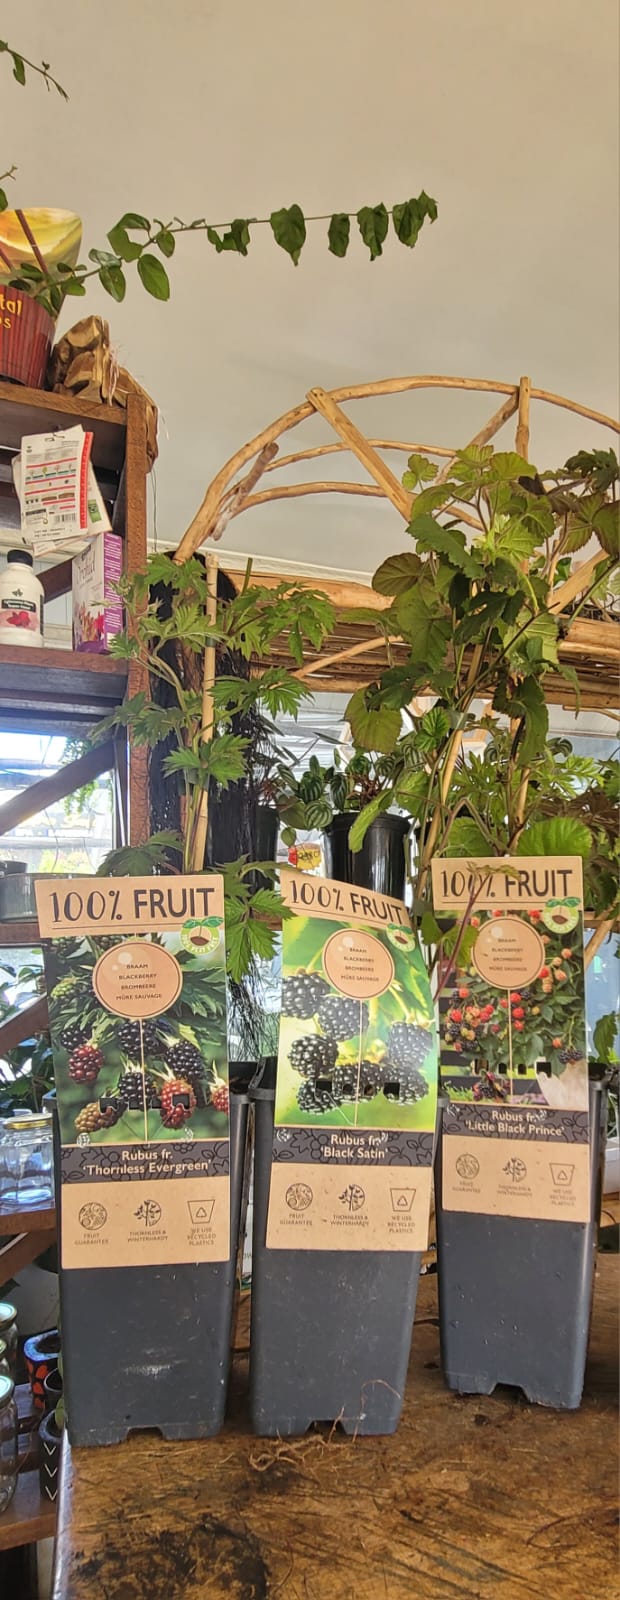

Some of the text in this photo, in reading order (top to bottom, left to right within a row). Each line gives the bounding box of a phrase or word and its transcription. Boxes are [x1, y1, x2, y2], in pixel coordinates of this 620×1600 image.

[505, 869, 573, 897] FRUIT
[49, 888, 215, 922] 100% FRUIT
[290, 880, 402, 925] 100% FRUIT
[492, 1110, 524, 1122] Rubus
[465, 1120, 565, 1136] 'Little Black Prince'
[330, 1134, 365, 1146] Rubus
[122, 1148, 174, 1161] Rubus fr.
[320, 1146, 388, 1159] 'Black Satin'
[82, 1159, 212, 1176] 'Thornless Evergreen'
[74, 1238, 109, 1246] GUARANTEE
